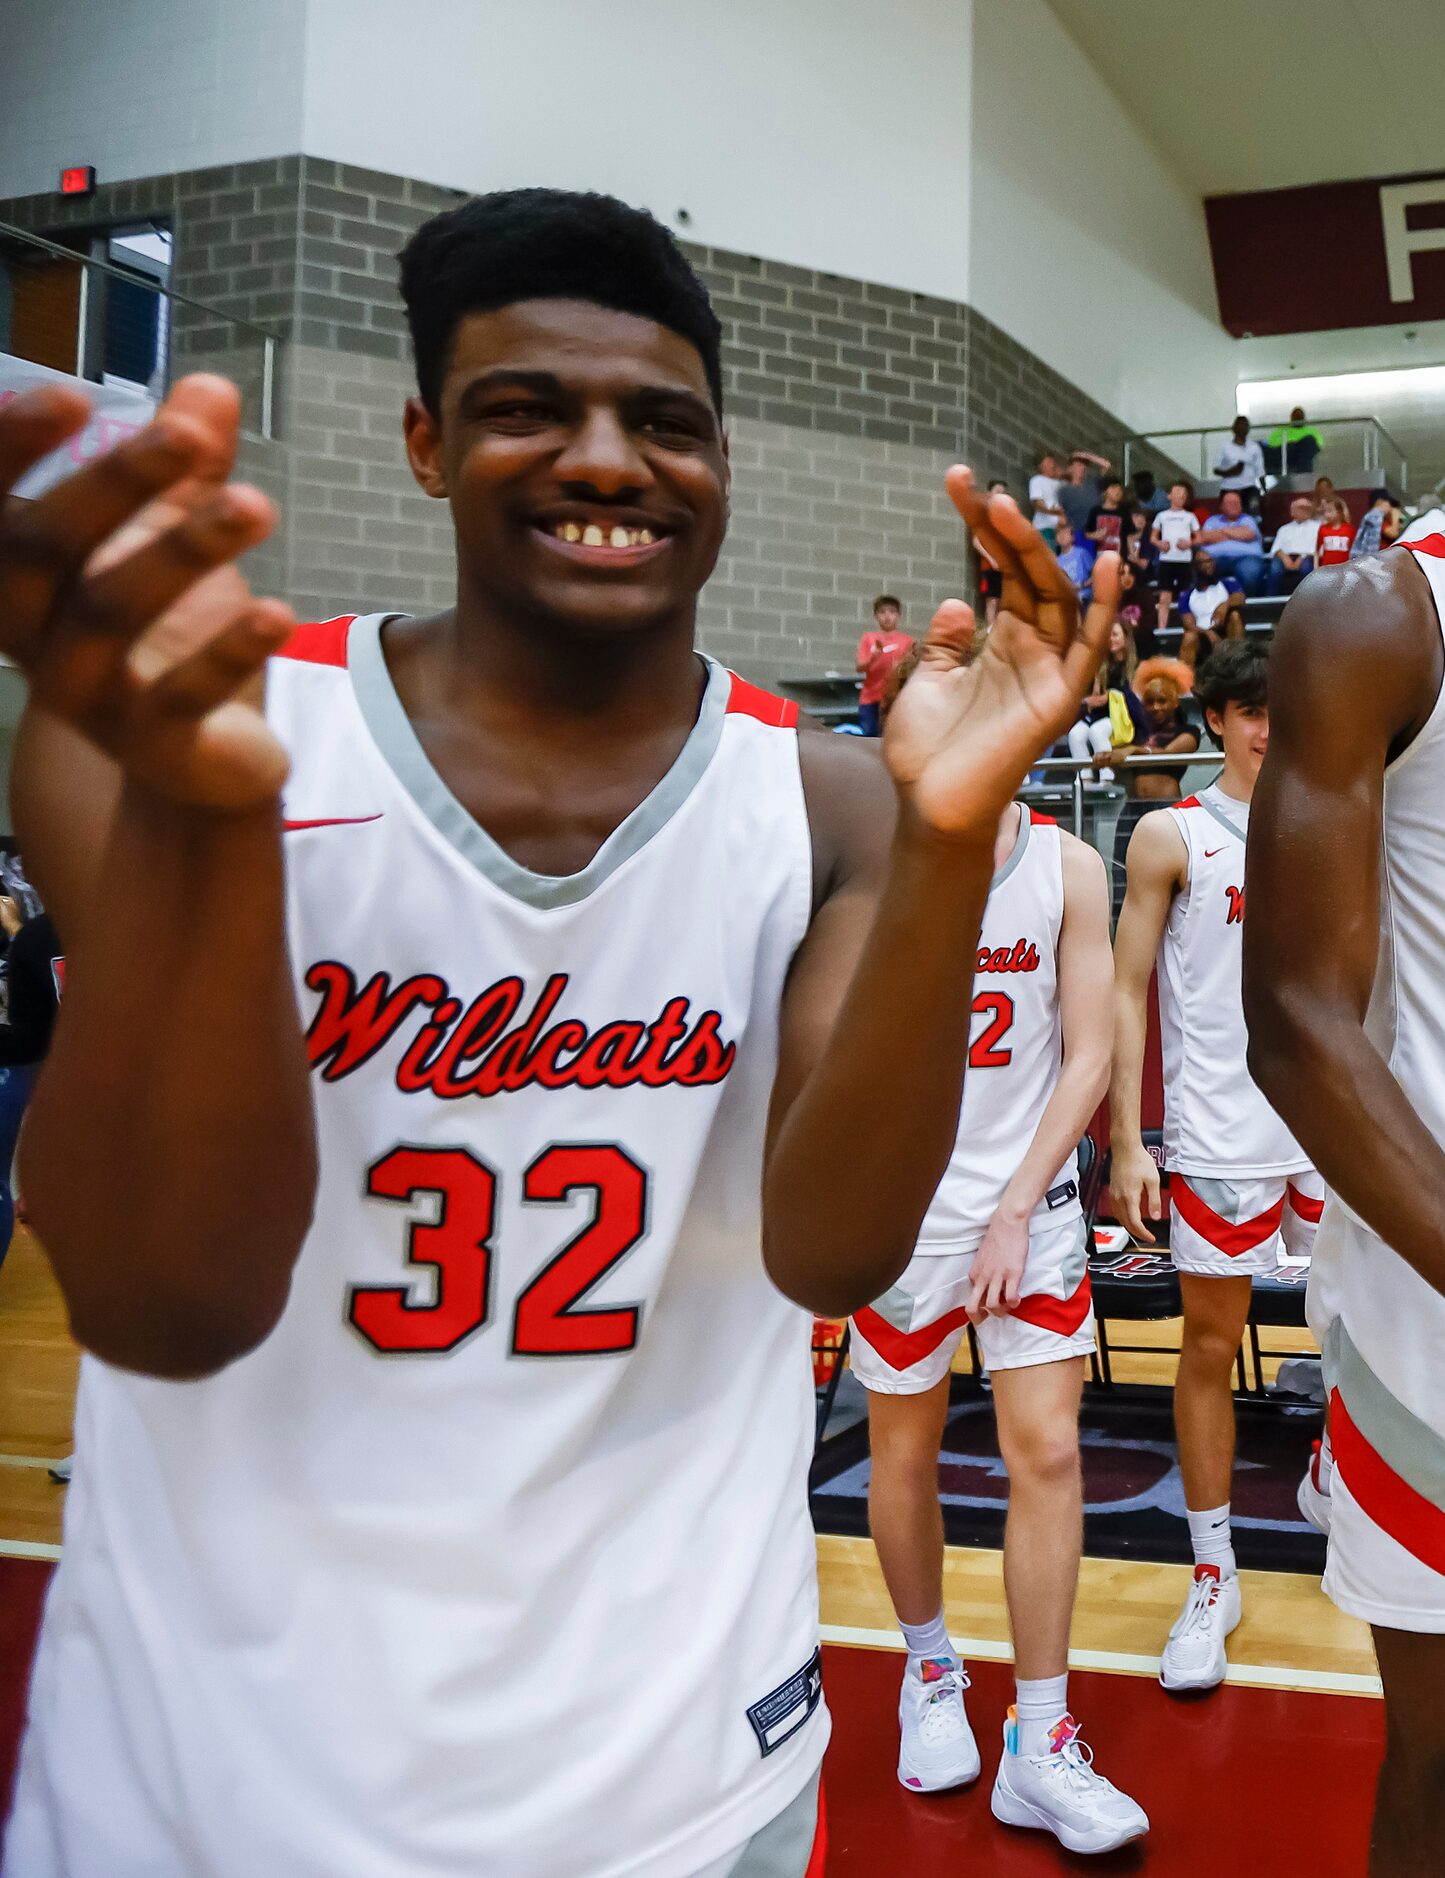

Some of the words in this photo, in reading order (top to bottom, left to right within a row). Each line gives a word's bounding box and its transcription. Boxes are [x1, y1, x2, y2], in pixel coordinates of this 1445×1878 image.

[974, 936, 1041, 974] cats
[304, 960, 737, 1100] Wildcats
[342, 1139, 651, 1362] 32
